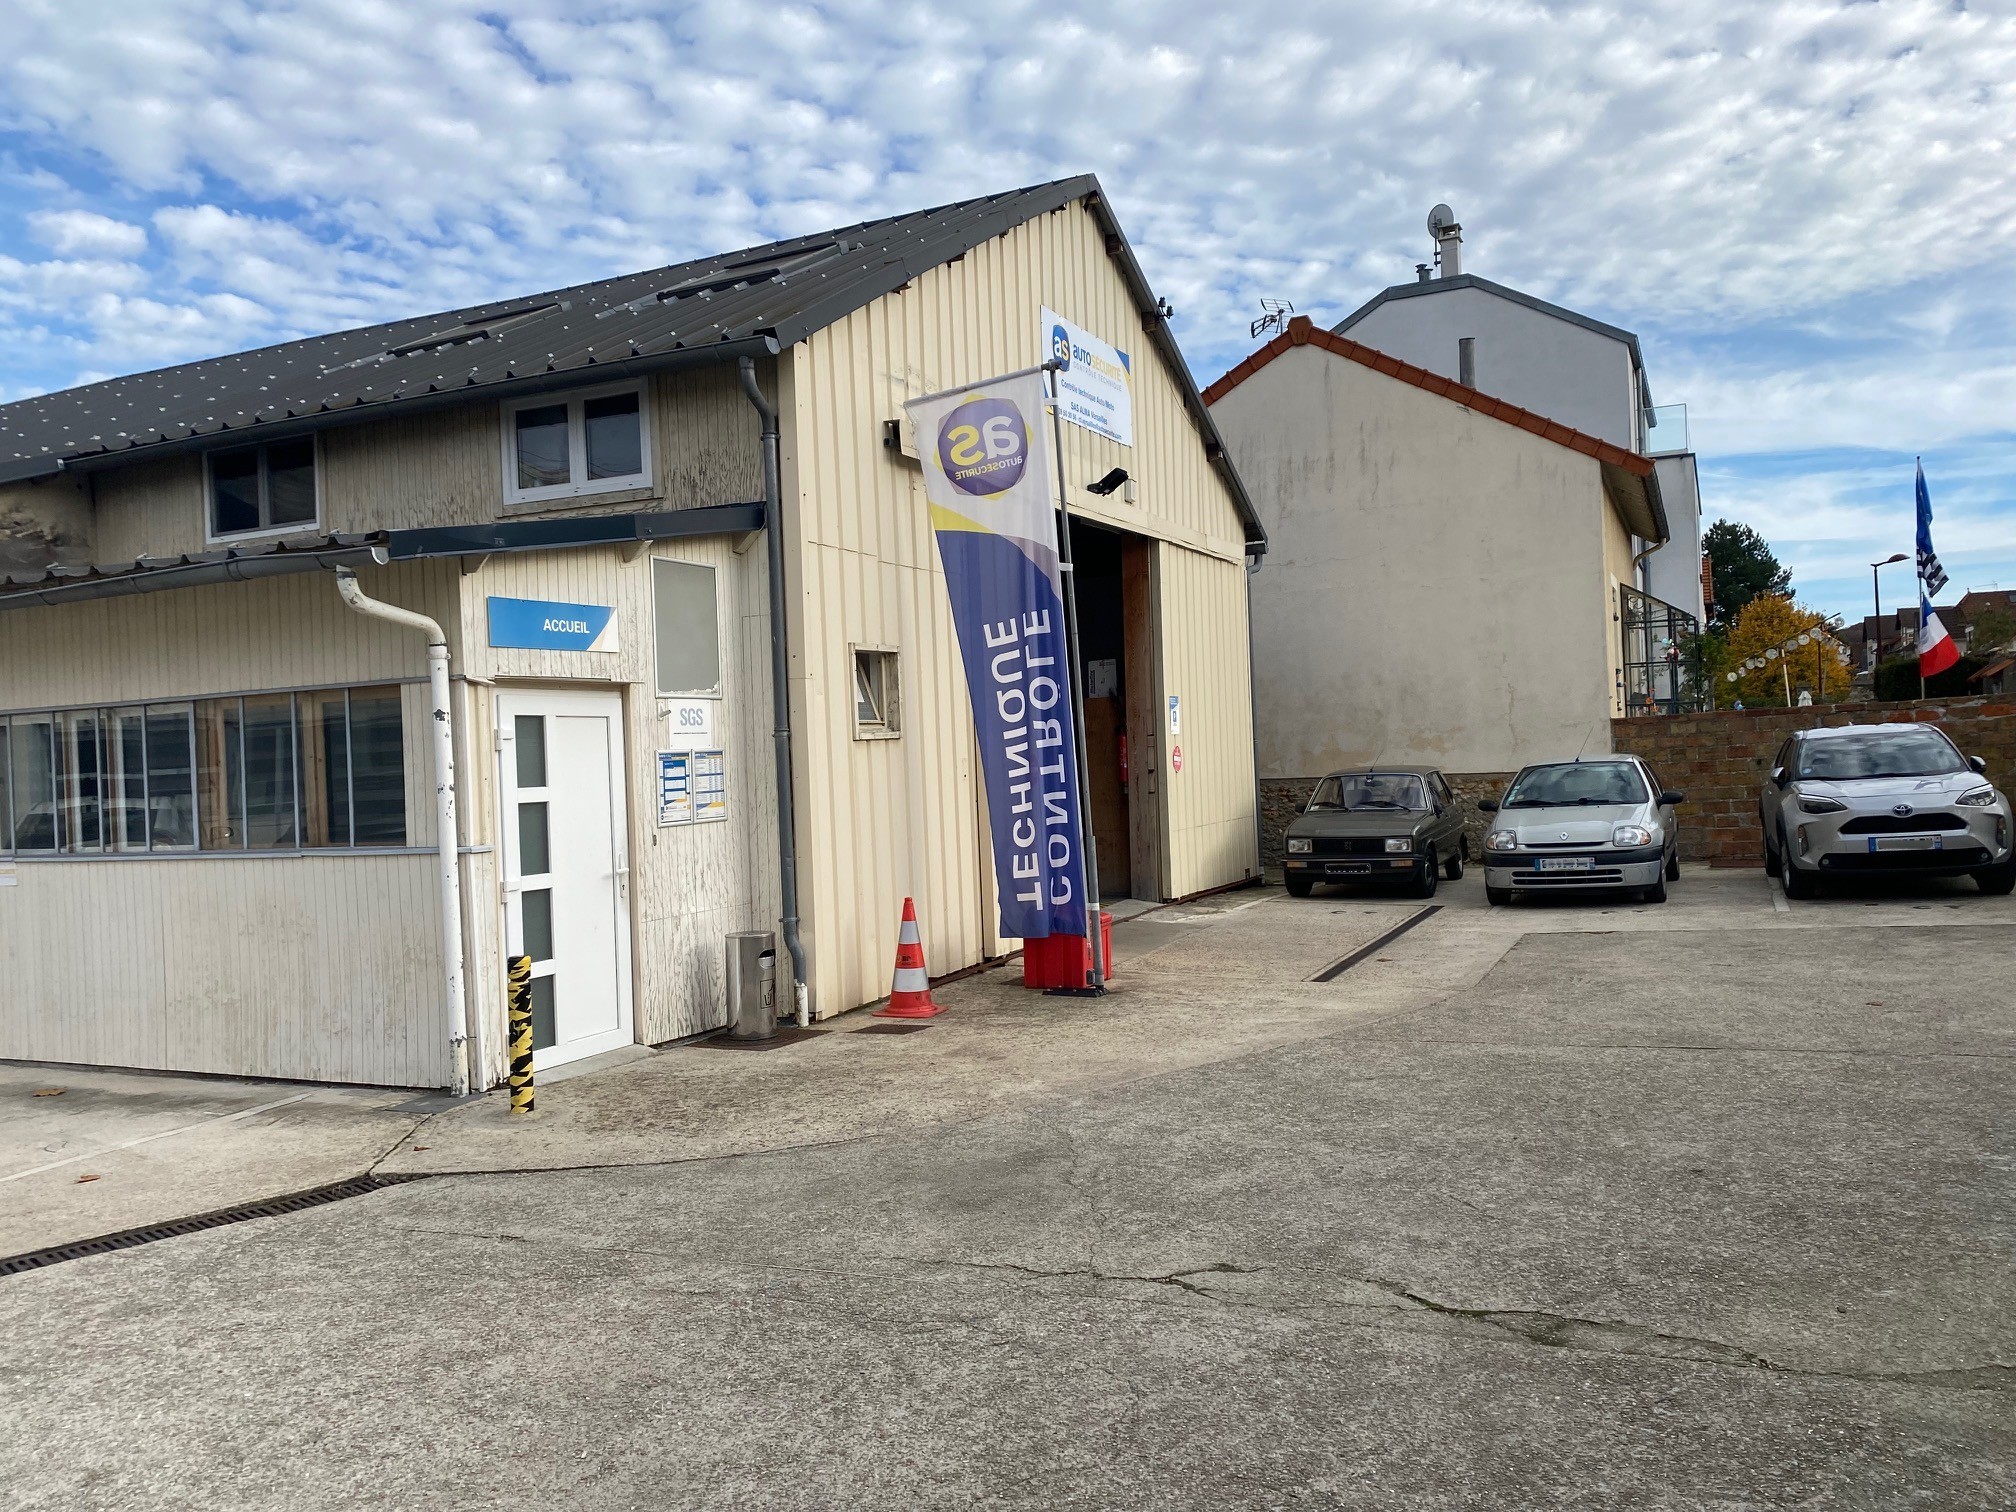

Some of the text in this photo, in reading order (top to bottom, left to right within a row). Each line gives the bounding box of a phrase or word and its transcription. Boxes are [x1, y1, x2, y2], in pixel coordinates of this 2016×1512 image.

[1054, 336, 1070, 361] as
[543, 618, 590, 634] ACCUEIL
[679, 707, 704, 727] SGS
